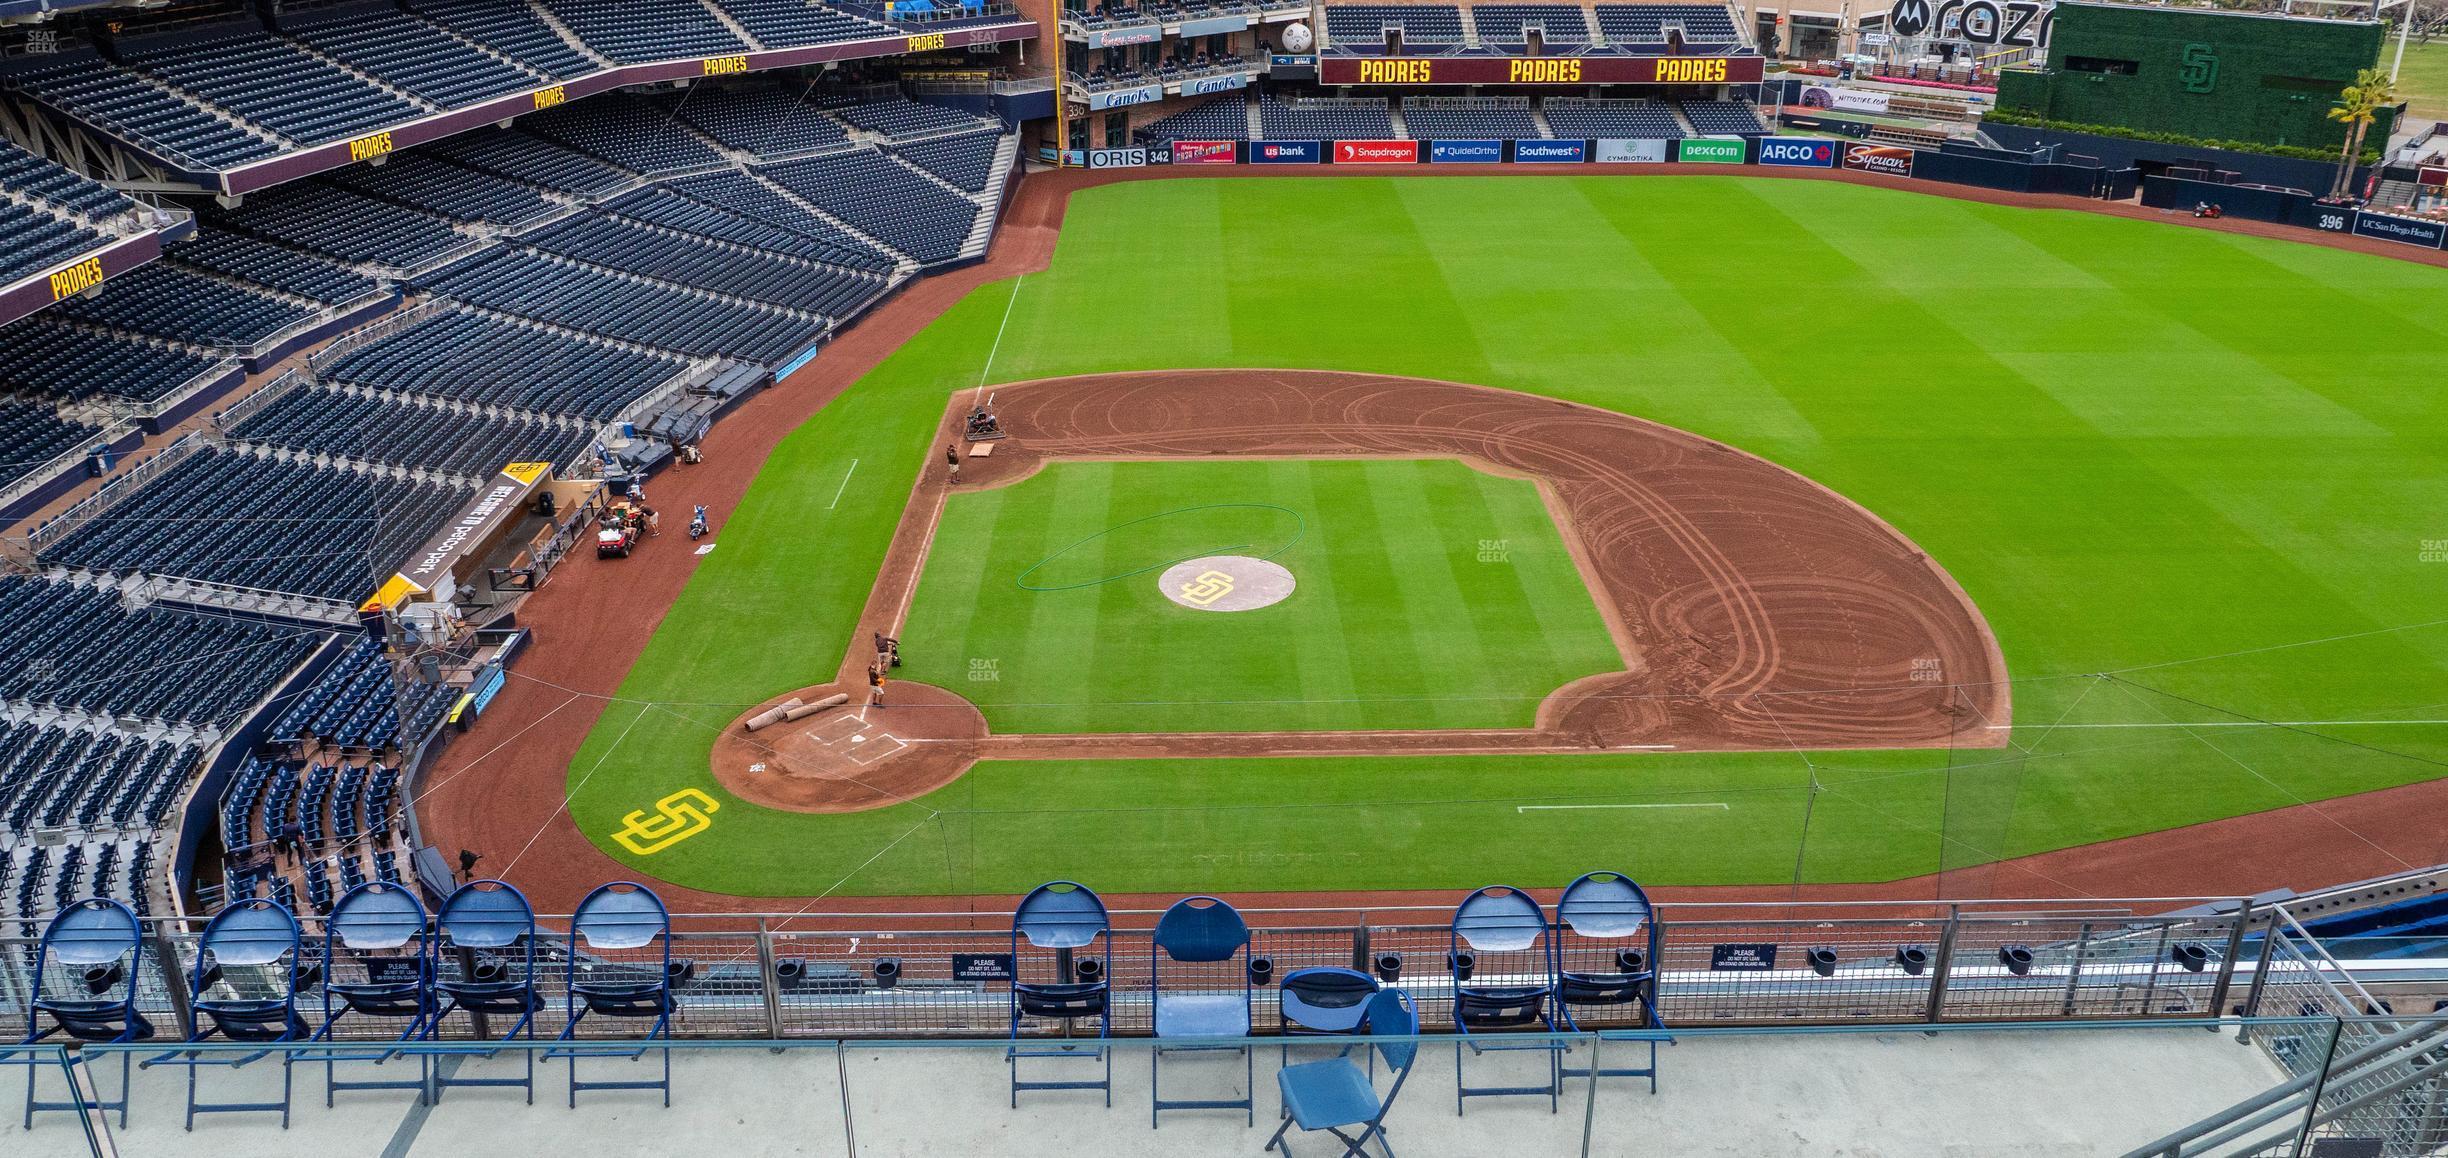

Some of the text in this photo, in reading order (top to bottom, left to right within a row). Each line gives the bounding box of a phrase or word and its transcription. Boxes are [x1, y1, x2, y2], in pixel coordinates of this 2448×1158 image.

[908, 34, 945, 52] PADRES
[704, 55, 747, 76] PADRES
[1360, 60, 1430, 82] PADRES
[1510, 60, 1581, 82] PADRES
[1655, 59, 1727, 82] PADRES
[534, 86, 565, 109] PADRES
[1069, 104, 1085, 117] 336
[349, 132, 393, 161] PADRES
[1279, 146, 1304, 156] bank
[1358, 147, 1412, 158] Snapdragon
[1520, 146, 1572, 156] Southwest
[1761, 145, 1813, 160] ARCO
[1092, 150, 1144, 167] ORIS
[1150, 151, 1169, 163] 342
[1847, 146, 1905, 169] Sycuan
[2319, 214, 2344, 230] 396
[2363, 219, 2435, 239] UC San Diego Health
[51, 257, 103, 300] PADRES
[412, 486, 516, 574] WELCOME TO petco park
